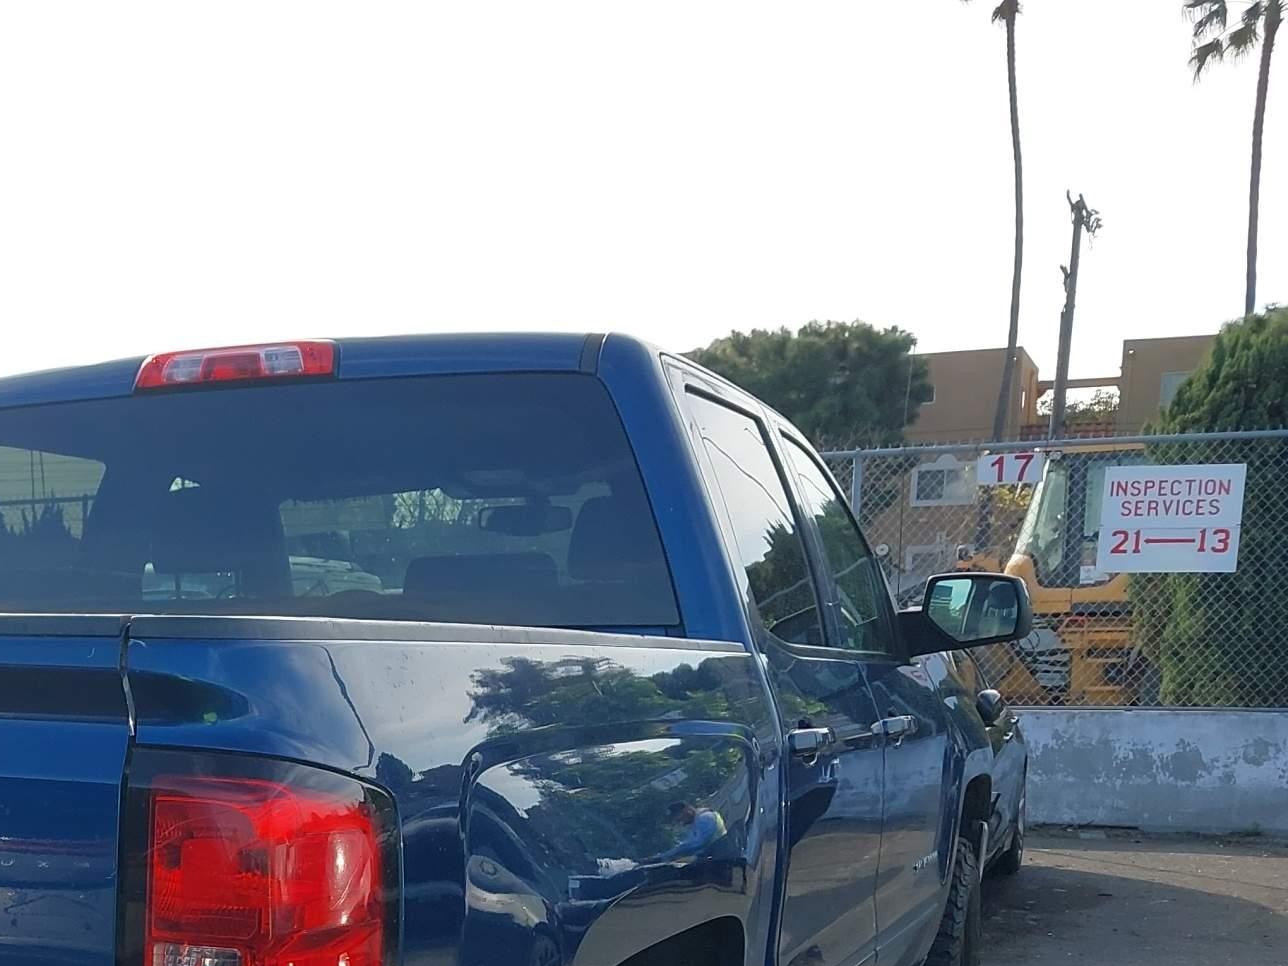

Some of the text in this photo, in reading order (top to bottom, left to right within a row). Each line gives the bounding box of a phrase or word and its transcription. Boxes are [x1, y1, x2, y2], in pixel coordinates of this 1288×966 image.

[990, 454, 1034, 483] 17
[1110, 478, 1232, 498] INSPECTION
[1120, 498, 1221, 517] SERVICES
